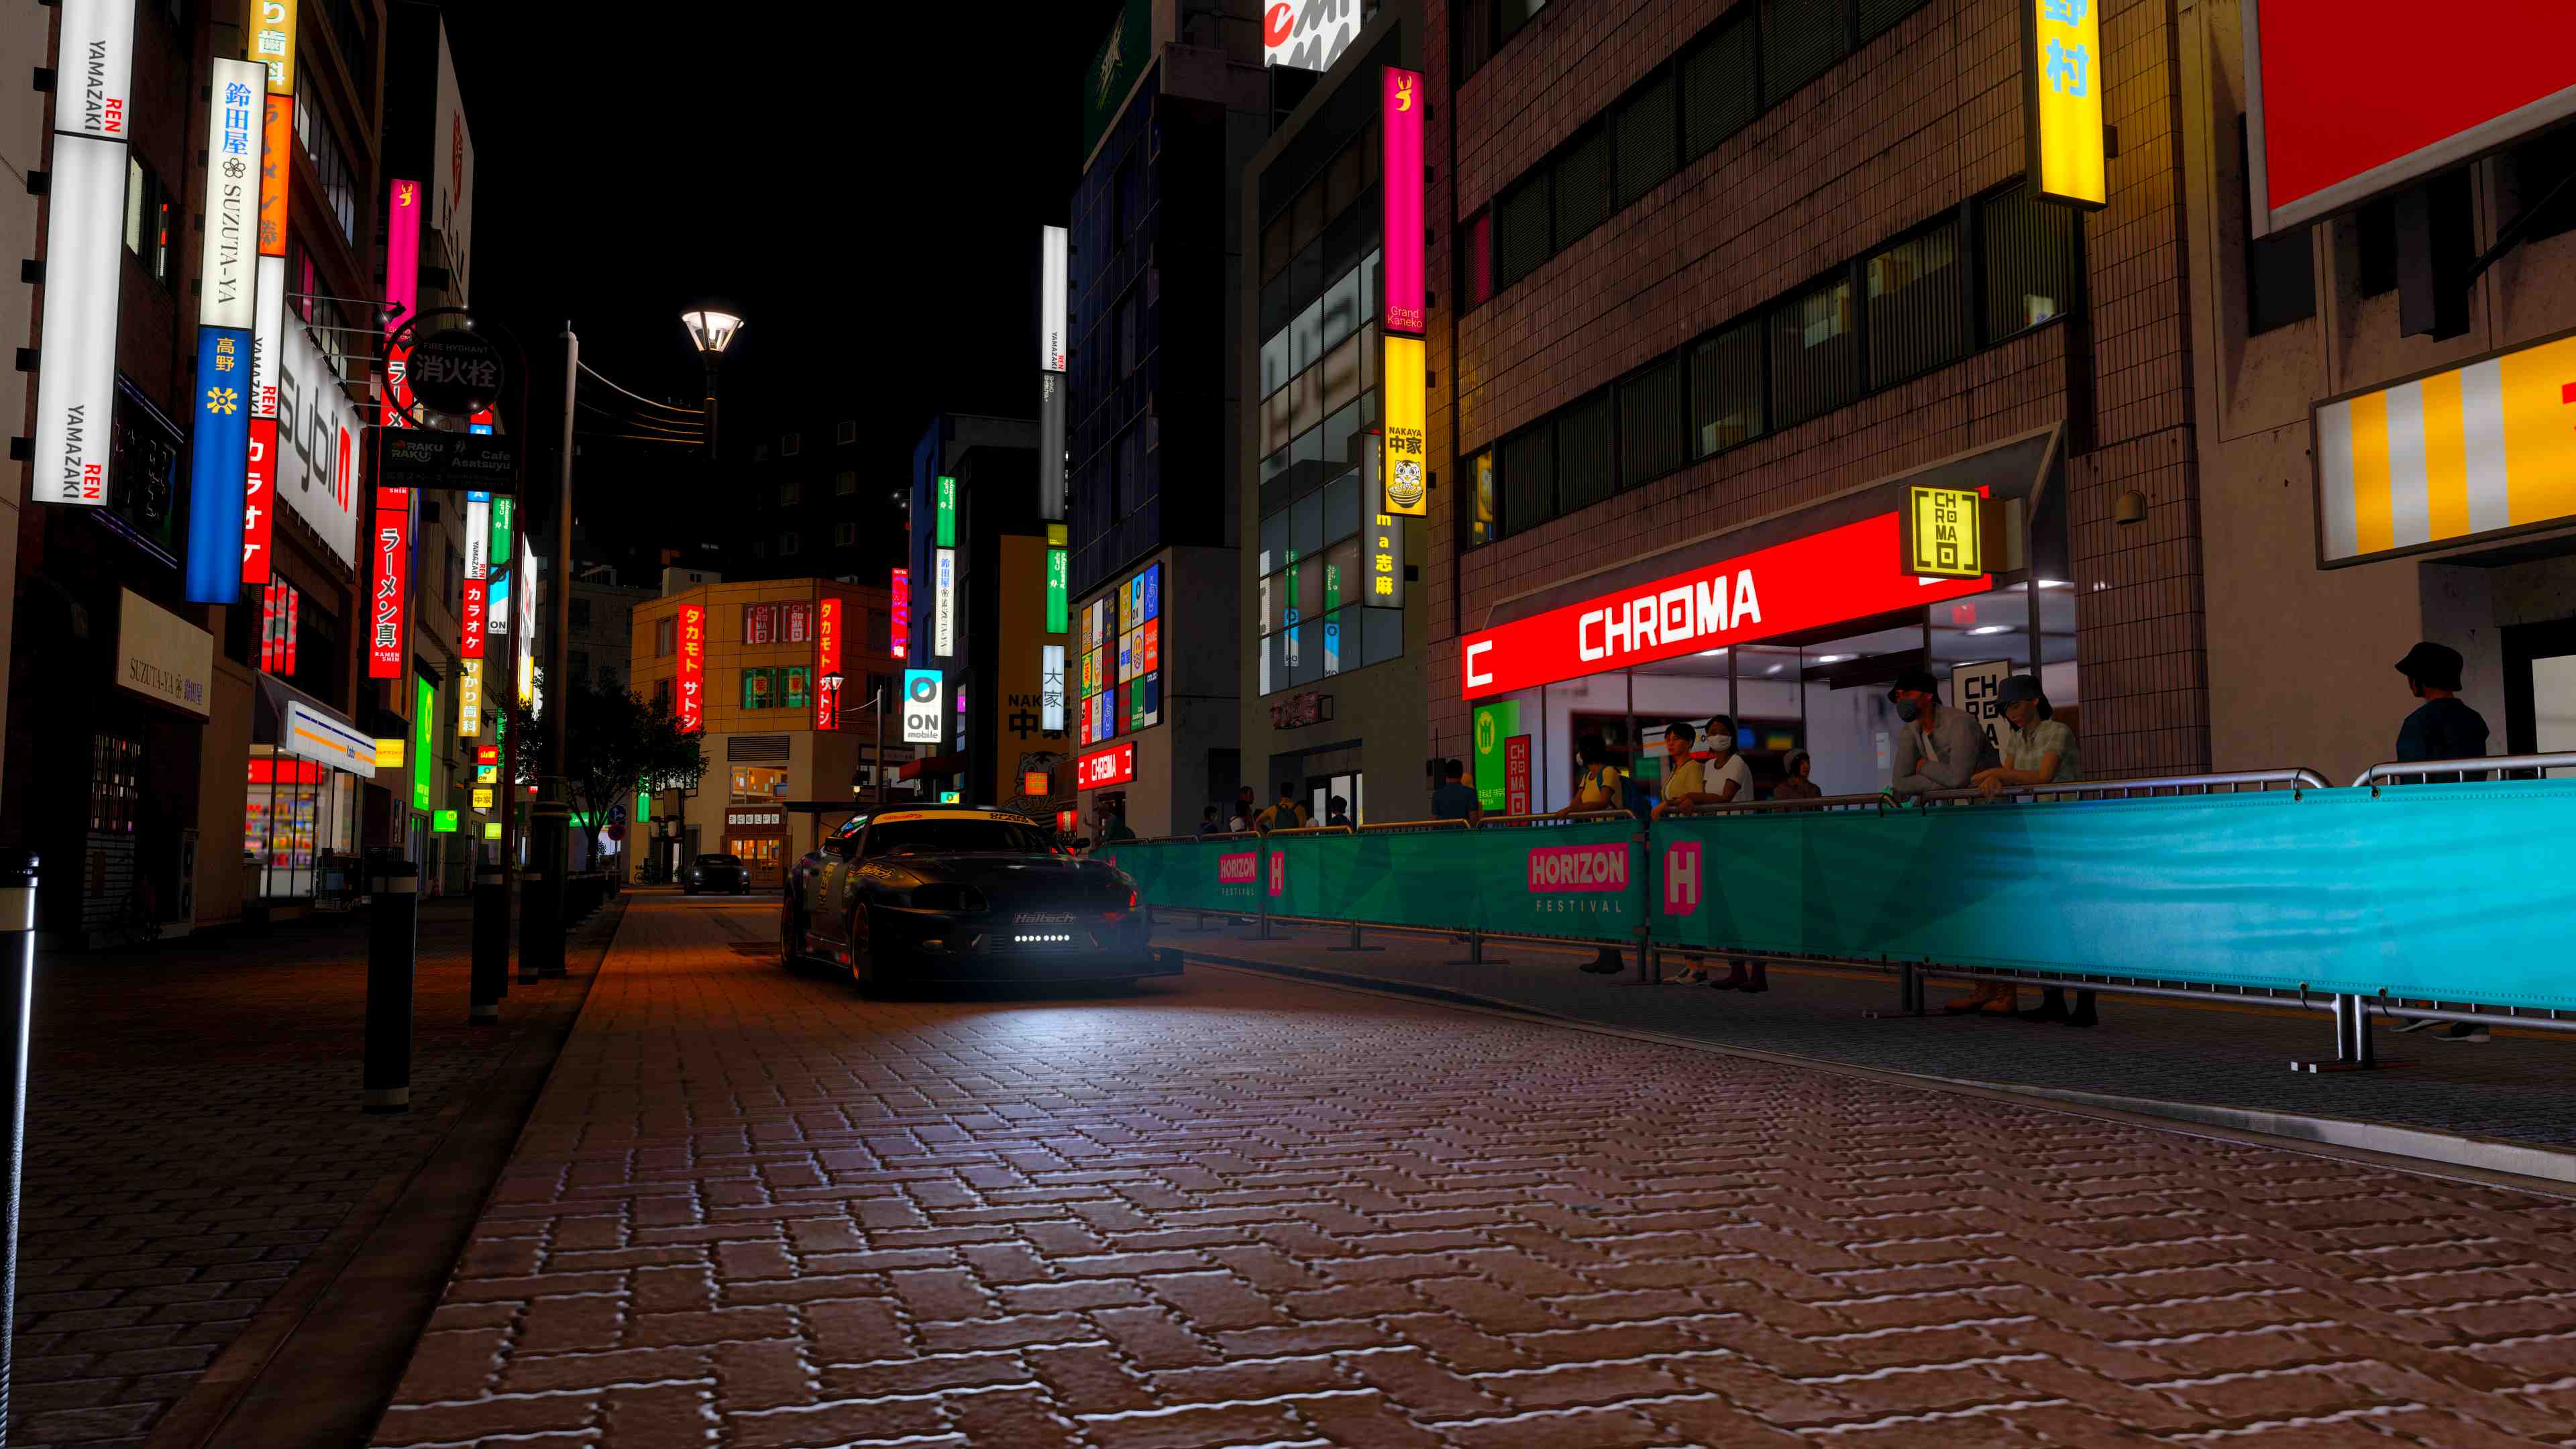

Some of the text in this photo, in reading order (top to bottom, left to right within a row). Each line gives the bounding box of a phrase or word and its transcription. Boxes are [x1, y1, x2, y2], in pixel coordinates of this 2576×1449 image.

[85, 40, 105, 131] YAMAZAKI
[105, 98, 123, 133] REN
[222, 81, 252, 156] 鈴田屋
[218, 183, 241, 304] SUZUTA-YA
[1387, 314, 1423, 328] Kaneko
[1391, 306, 1419, 318] Grand
[215, 337, 235, 372] 高野
[423, 342, 488, 354] FIRE HYDRANT
[415, 353, 497, 388] 消火栓
[262, 386, 276, 415] REN
[406, 443, 444, 451] RAKU
[1389, 427, 1421, 437] NAKAYA
[1389, 436, 1422, 455] 中家
[63, 405, 85, 499] YAMAZAKI
[481, 450, 511, 460] Cafe
[83, 464, 101, 499] REN
[376, 528, 400, 648] ラーメン真
[478, 564, 486, 578] REN
[466, 588, 481, 649] カラオケ
[489, 621, 506, 629] ON
[1579, 568, 1762, 662] CHROMA
[684, 609, 699, 672] タカモト
[820, 604, 832, 668] タカモト
[130, 658, 173, 694] SUZUTA-YA
[1044, 667, 1063, 707] 大家
[462, 661, 478, 733] ひかり歯科
[684, 682, 698, 728] サトシ
[908, 714, 938, 730] ON
[908, 730, 938, 739] mobile
[1091, 753, 1116, 782] CHROMA
[1221, 857, 1256, 879] HORIZON
[1271, 857, 1282, 890] H
[1532, 850, 1624, 885] HORIZON
[1669, 851, 1696, 904] H
[1222, 887, 1256, 896] FESTIVAL
[1537, 900, 1621, 913] FESTIVAL
[1014, 912, 1075, 924] Haltech
